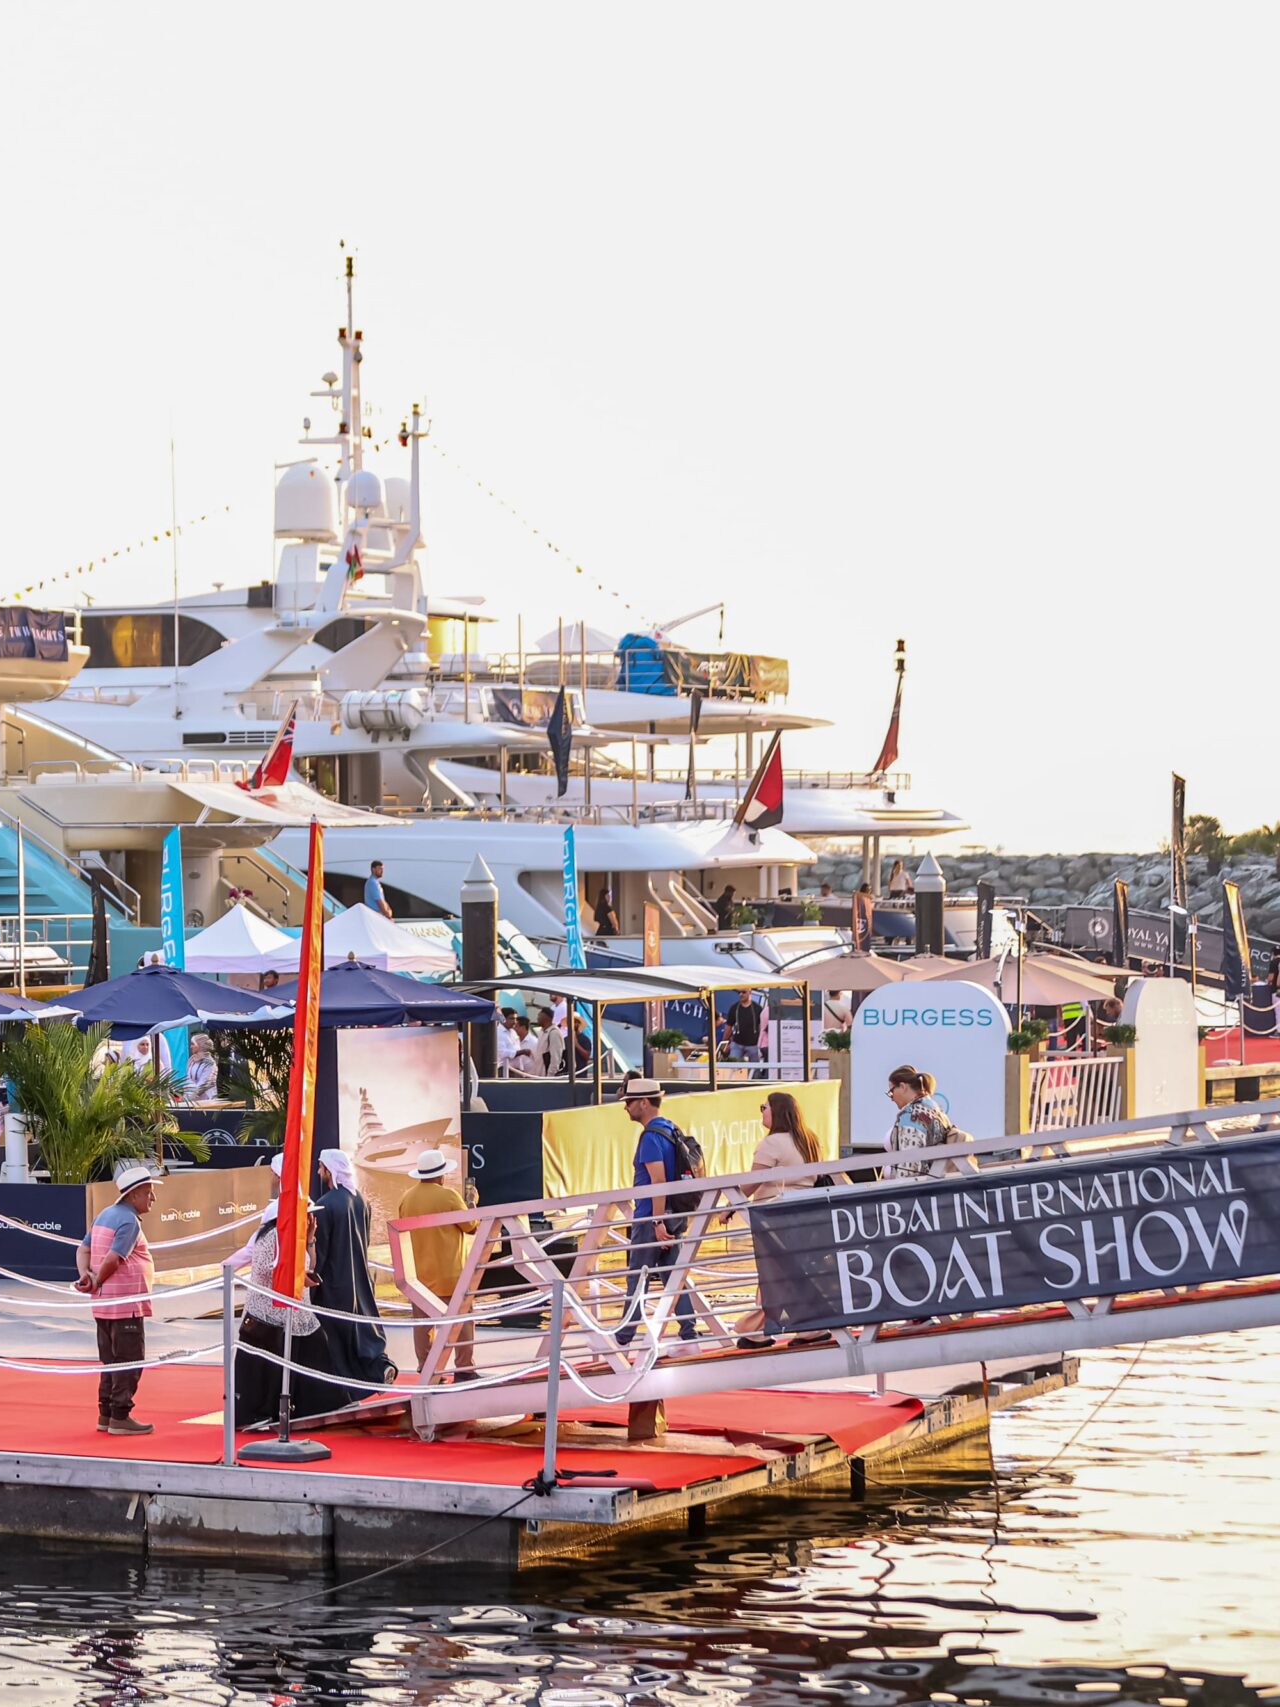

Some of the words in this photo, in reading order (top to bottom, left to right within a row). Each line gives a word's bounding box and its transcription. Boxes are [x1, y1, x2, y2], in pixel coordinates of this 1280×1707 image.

[161, 844, 177, 969] URGE
[563, 840, 578, 968] URGES
[1128, 927, 1151, 941] YAL
[863, 1008, 993, 1027] BURGESS
[32, 1221, 62, 1231] noble
[831, 1197, 939, 1243] DUBAI
[954, 1157, 1246, 1228] INTERNATIONAL
[836, 1230, 1012, 1314] BOAT
[1039, 1200, 1249, 1289] SHOW
